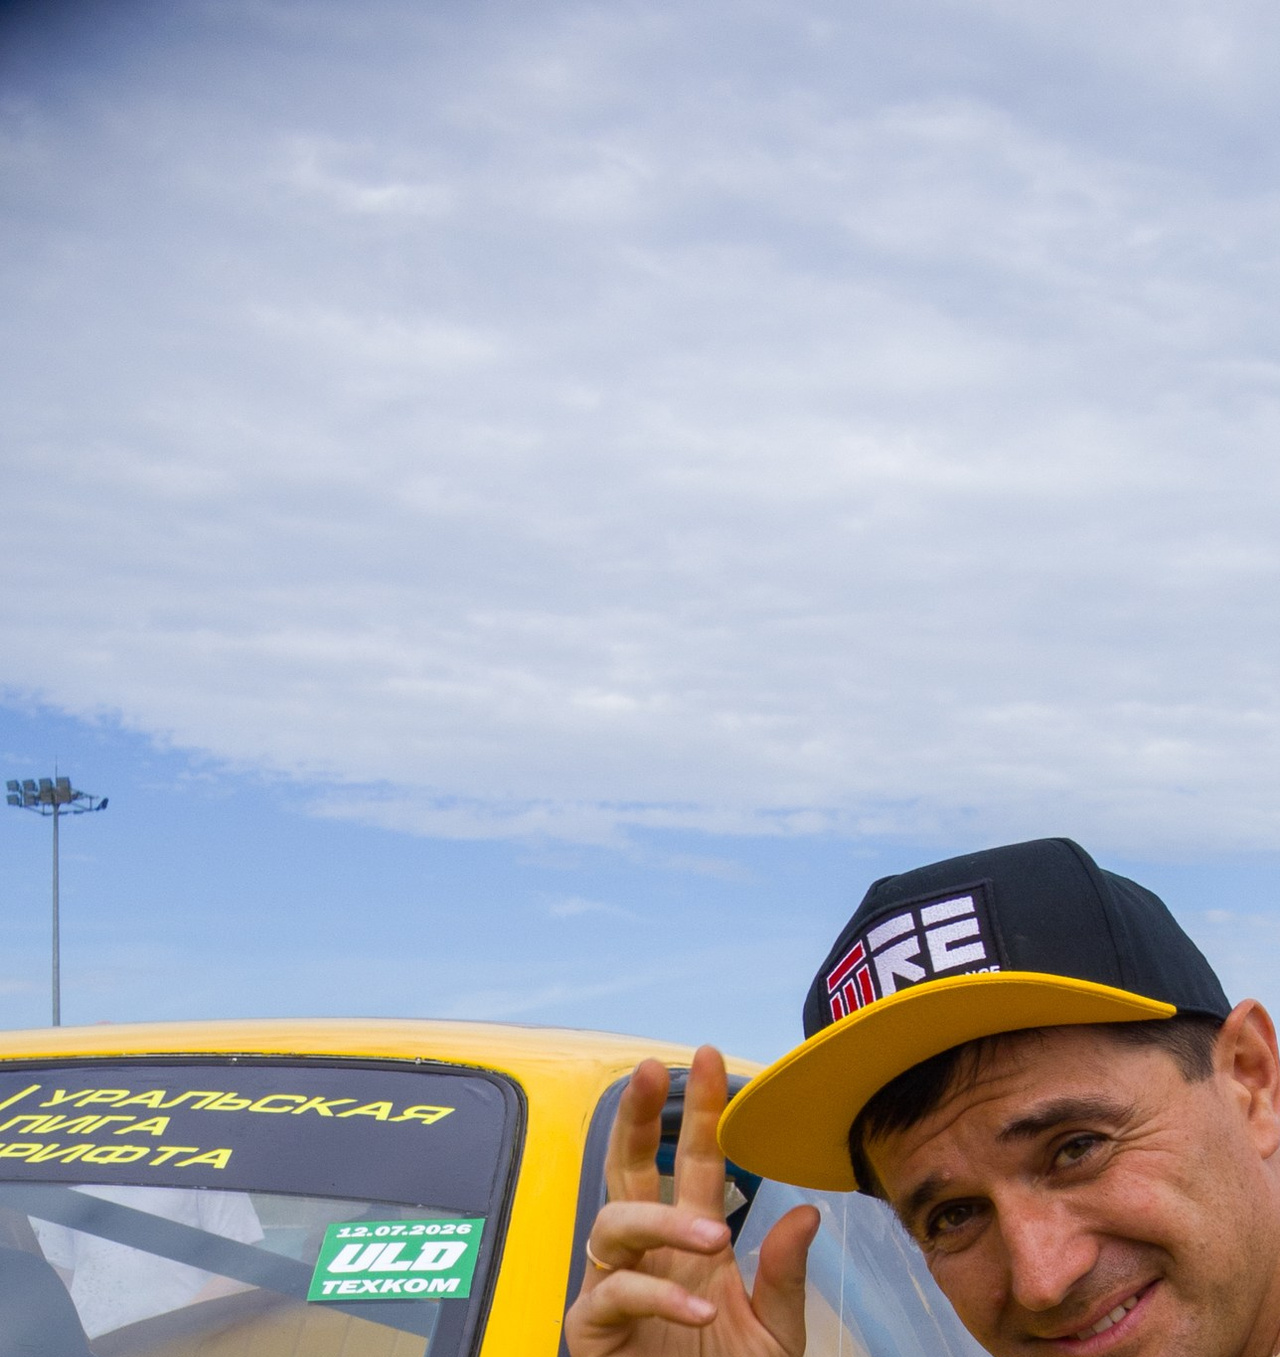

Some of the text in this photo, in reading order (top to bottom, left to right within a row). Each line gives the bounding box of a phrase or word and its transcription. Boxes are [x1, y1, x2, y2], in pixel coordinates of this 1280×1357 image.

[39, 1089, 456, 1124] УРАЛЬСКАЯ
[0, 1115, 171, 1135] ЛИГА
[0, 1143, 233, 1169] РИФТА
[336, 1224, 473, 1238] 12.07.2026
[327, 1241, 468, 1273] ULD
[321, 1278, 461, 1294] ТЕХКОМ
